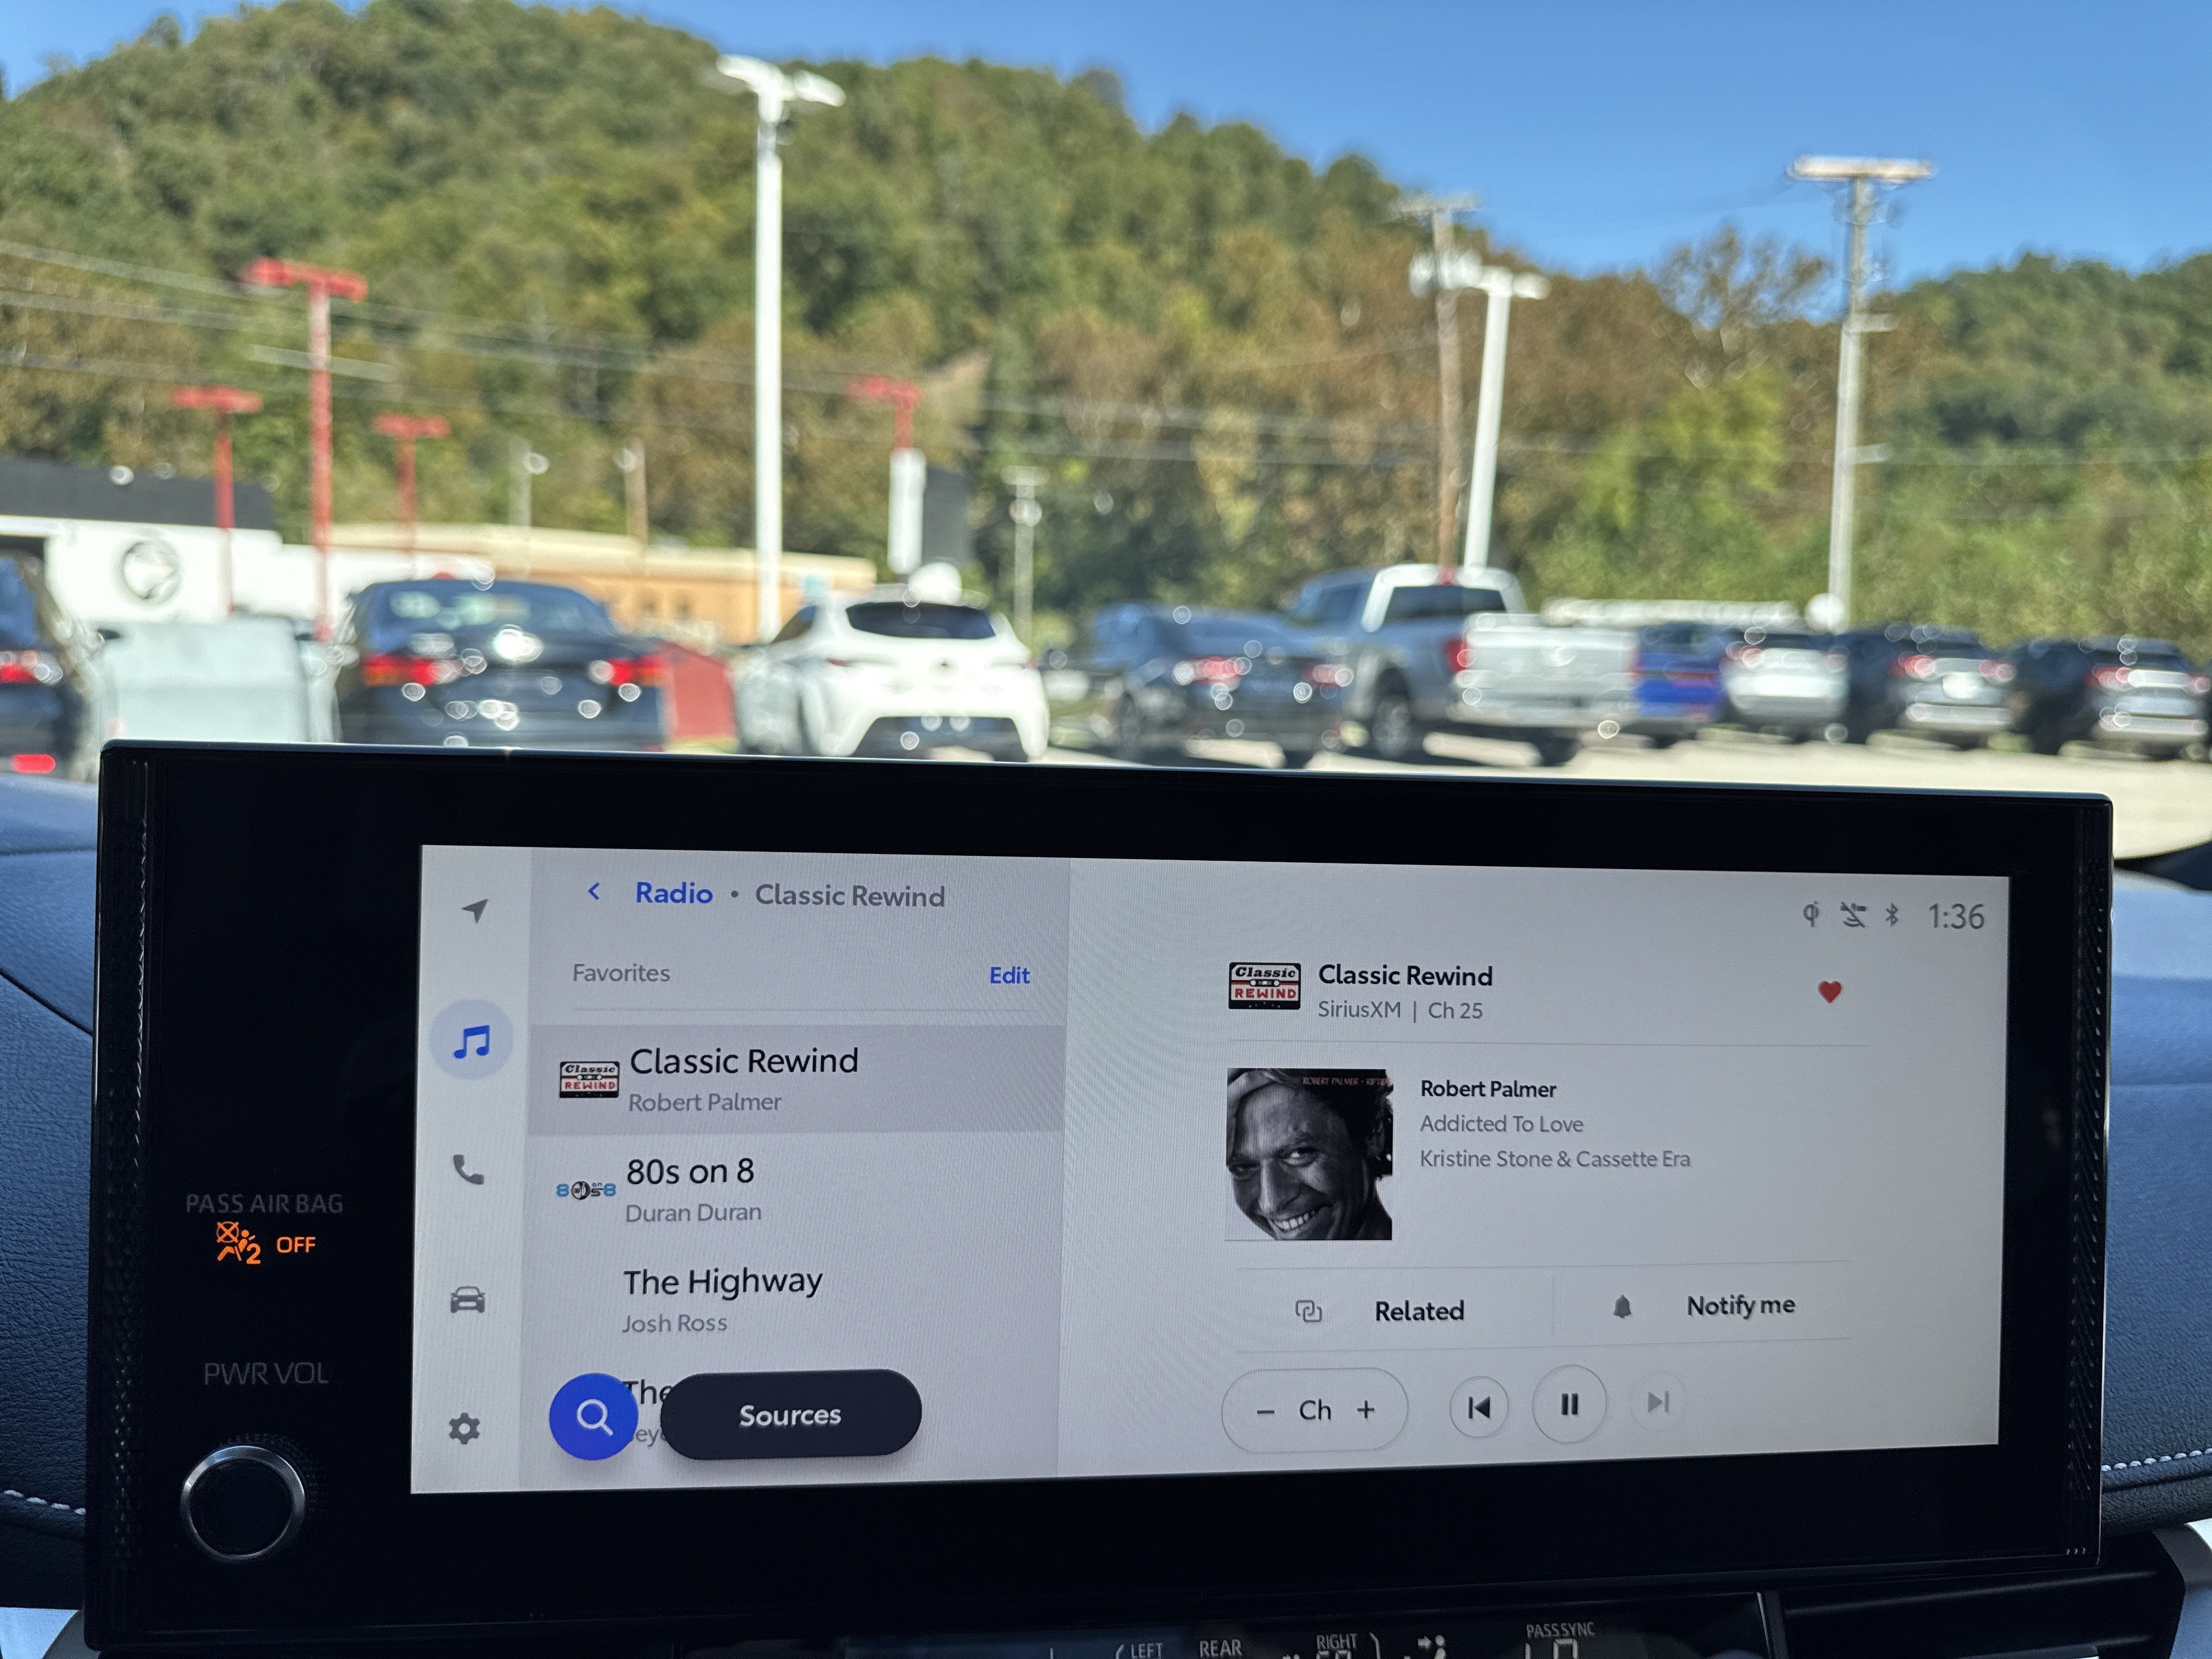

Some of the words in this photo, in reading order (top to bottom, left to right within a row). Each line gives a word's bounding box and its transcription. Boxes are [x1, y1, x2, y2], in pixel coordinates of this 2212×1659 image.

[637, 882, 713, 904] Radio
[756, 883, 844, 905] Classic
[853, 885, 945, 907] Rewind
[1930, 904, 1984, 929] 1:36
[574, 964, 670, 981] Favorites
[991, 967, 1030, 984] Edit
[1235, 967, 1295, 977] Classic
[1319, 964, 1400, 985] Classic
[1407, 966, 1492, 986] Rewind
[1235, 988, 1296, 998] REWIND
[1319, 1001, 1401, 1018] SiriusXM
[1429, 1002, 1454, 1018] Ch
[1460, 1003, 1482, 1019] 25
[631, 1048, 738, 1074] Classic
[749, 1047, 857, 1073] Rewind
[565, 1081, 616, 1090] REWIND
[1422, 1080, 1486, 1097] Robert
[1491, 1080, 1556, 1097] Palmer
[629, 1093, 702, 1111] Robert
[708, 1093, 782, 1111] Palmer
[1420, 1115, 1506, 1132] Addicted
[1513, 1116, 1534, 1132] To
[1540, 1116, 1584, 1132] Love
[1421, 1150, 1491, 1167] Kristine
[1497, 1150, 1553, 1167] Stone
[1557, 1151, 1571, 1167] &
[1577, 1151, 1658, 1167] Cassette
[1663, 1150, 1690, 1167] Era
[628, 1159, 679, 1184] 80s
[690, 1165, 727, 1183] on
[737, 1158, 754, 1183] 8
[186, 1194, 243, 1214] PASS
[250, 1194, 290, 1214] AIR
[296, 1194, 343, 1214] BAG
[626, 1205, 690, 1222] Duran
[698, 1204, 761, 1221] Duran
[277, 1237, 316, 1253] OFF
[624, 1269, 679, 1295] The
[690, 1267, 822, 1301] Highway
[1376, 1300, 1464, 1321] Related
[1688, 1295, 1755, 1319] Notify
[1761, 1300, 1795, 1313] me
[622, 1314, 671, 1333] Josh
[678, 1314, 727, 1331] Ross
[204, 1362, 268, 1385] PWR
[274, 1362, 329, 1385] VOL
[741, 1405, 841, 1426] Sources
[1300, 1399, 1331, 1420] Ch
[1199, 1640, 1243, 1657] REAR
[1317, 1633, 1357, 1650] RIGHT
[1131, 1643, 1164, 1659] LEFT
